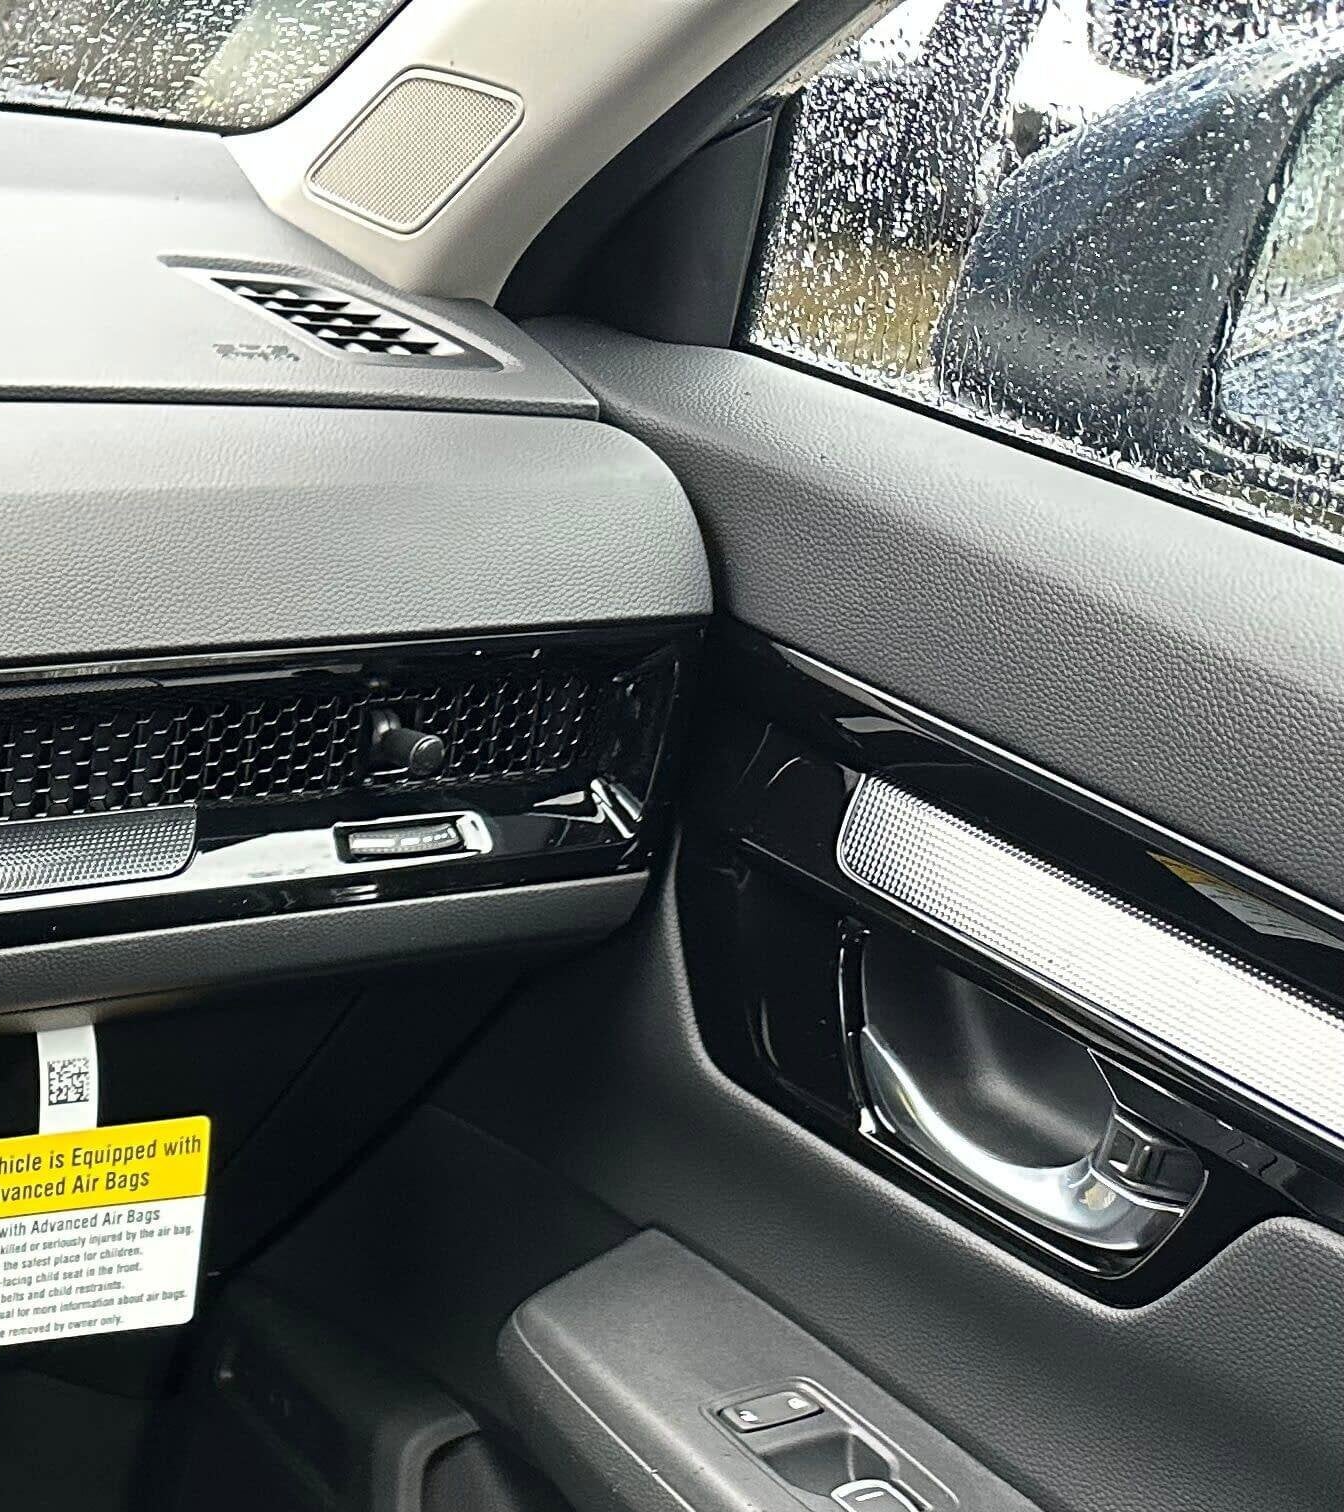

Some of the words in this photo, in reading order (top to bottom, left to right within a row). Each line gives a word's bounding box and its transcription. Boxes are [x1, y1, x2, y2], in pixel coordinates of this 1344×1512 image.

[49, 1150, 64, 1169] is
[72, 1139, 158, 1169] Equipped
[164, 1135, 201, 1157] with
[72, 1174, 99, 1194] Air
[105, 1171, 150, 1192] Bags
[31, 1213, 98, 1235] Advanced
[102, 1211, 123, 1227] Air
[127, 1209, 161, 1225] Bags
[30, 1243, 41, 1251] or
[126, 1230, 137, 1242] by
[140, 1228, 155, 1239] the
[157, 1226, 172, 1237] air
[4, 1260, 18, 1270] the
[54, 1253, 80, 1267] place
[84, 1251, 97, 1261] for
[36, 1271, 59, 1283] child
[62, 1269, 83, 1280] seat
[86, 1267, 95, 1277] in
[98, 1265, 113, 1276] the
[0, 1293, 24, 1304] belts
[28, 1288, 45, 1300] and
[48, 1285, 72, 1298] child
[17, 1307, 30, 1317] for
[33, 1304, 57, 1315] more
[117, 1294, 144, 1305] about
[146, 1292, 160, 1302] air
[8, 1322, 50, 1337] removed
[54, 1321, 65, 1332] by
[67, 1318, 98, 1330] owner
